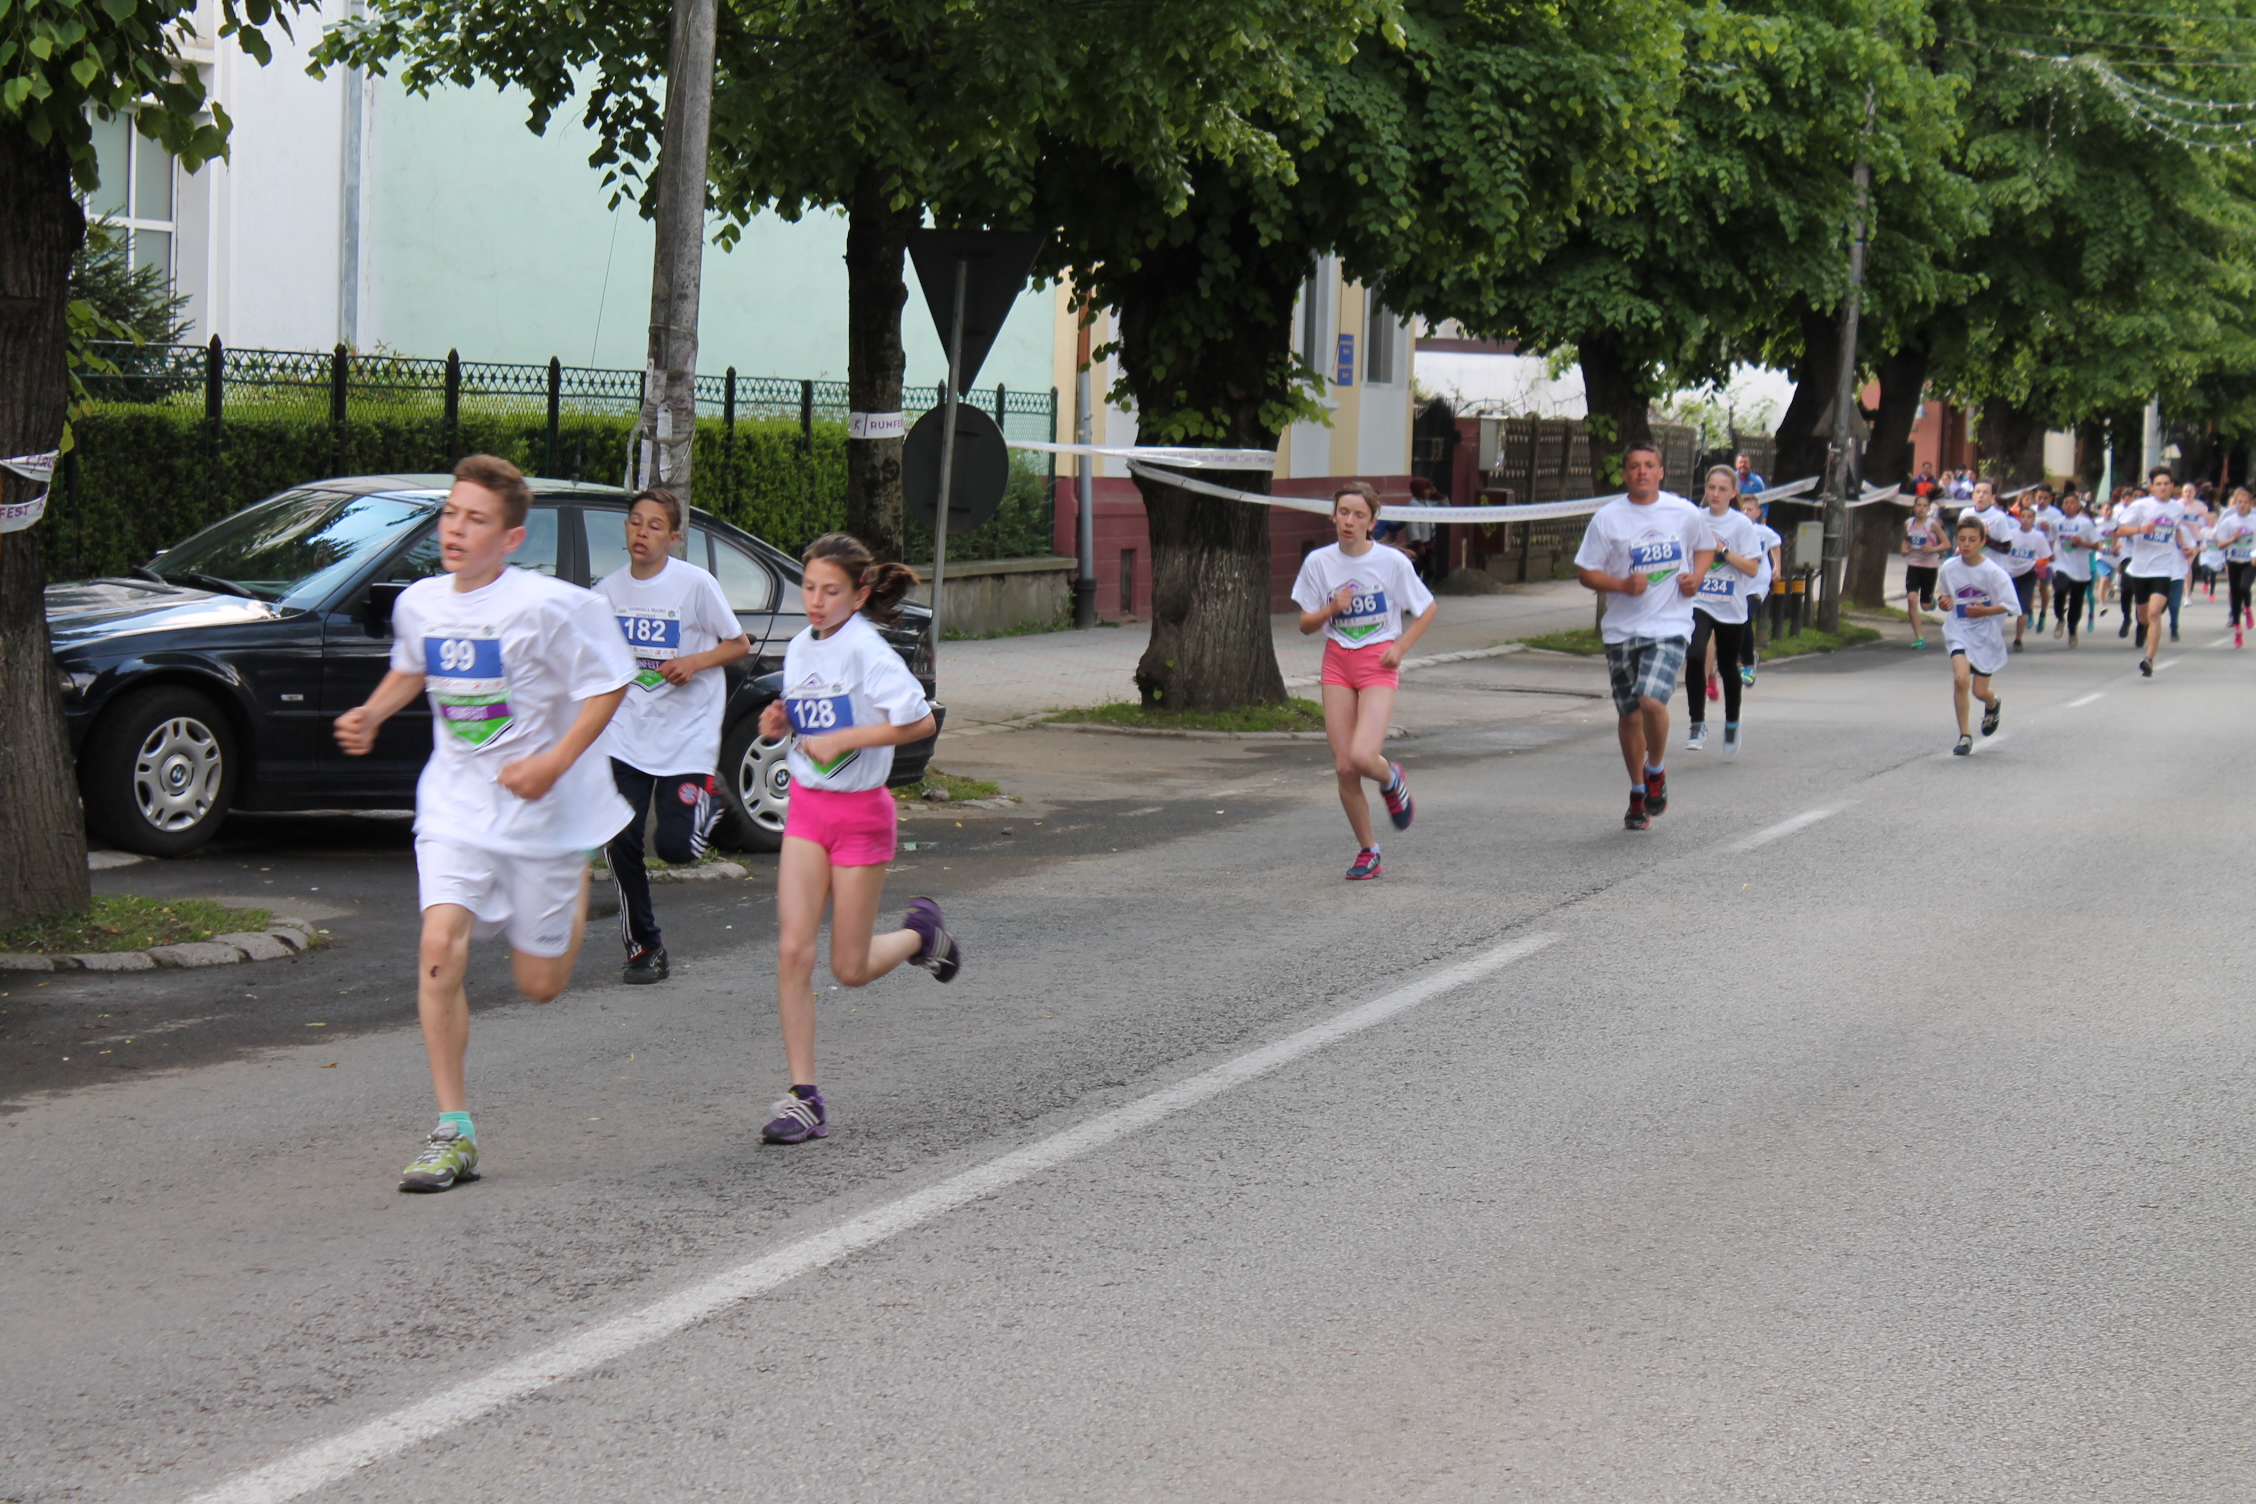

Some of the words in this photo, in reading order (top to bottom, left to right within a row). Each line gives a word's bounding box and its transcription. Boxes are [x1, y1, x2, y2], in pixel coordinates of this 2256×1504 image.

[1641, 543, 1673, 563] 288
[1702, 578, 1728, 593] 234
[624, 617, 667, 643] 182
[439, 638, 476, 672] 99
[793, 698, 837, 729] 128
